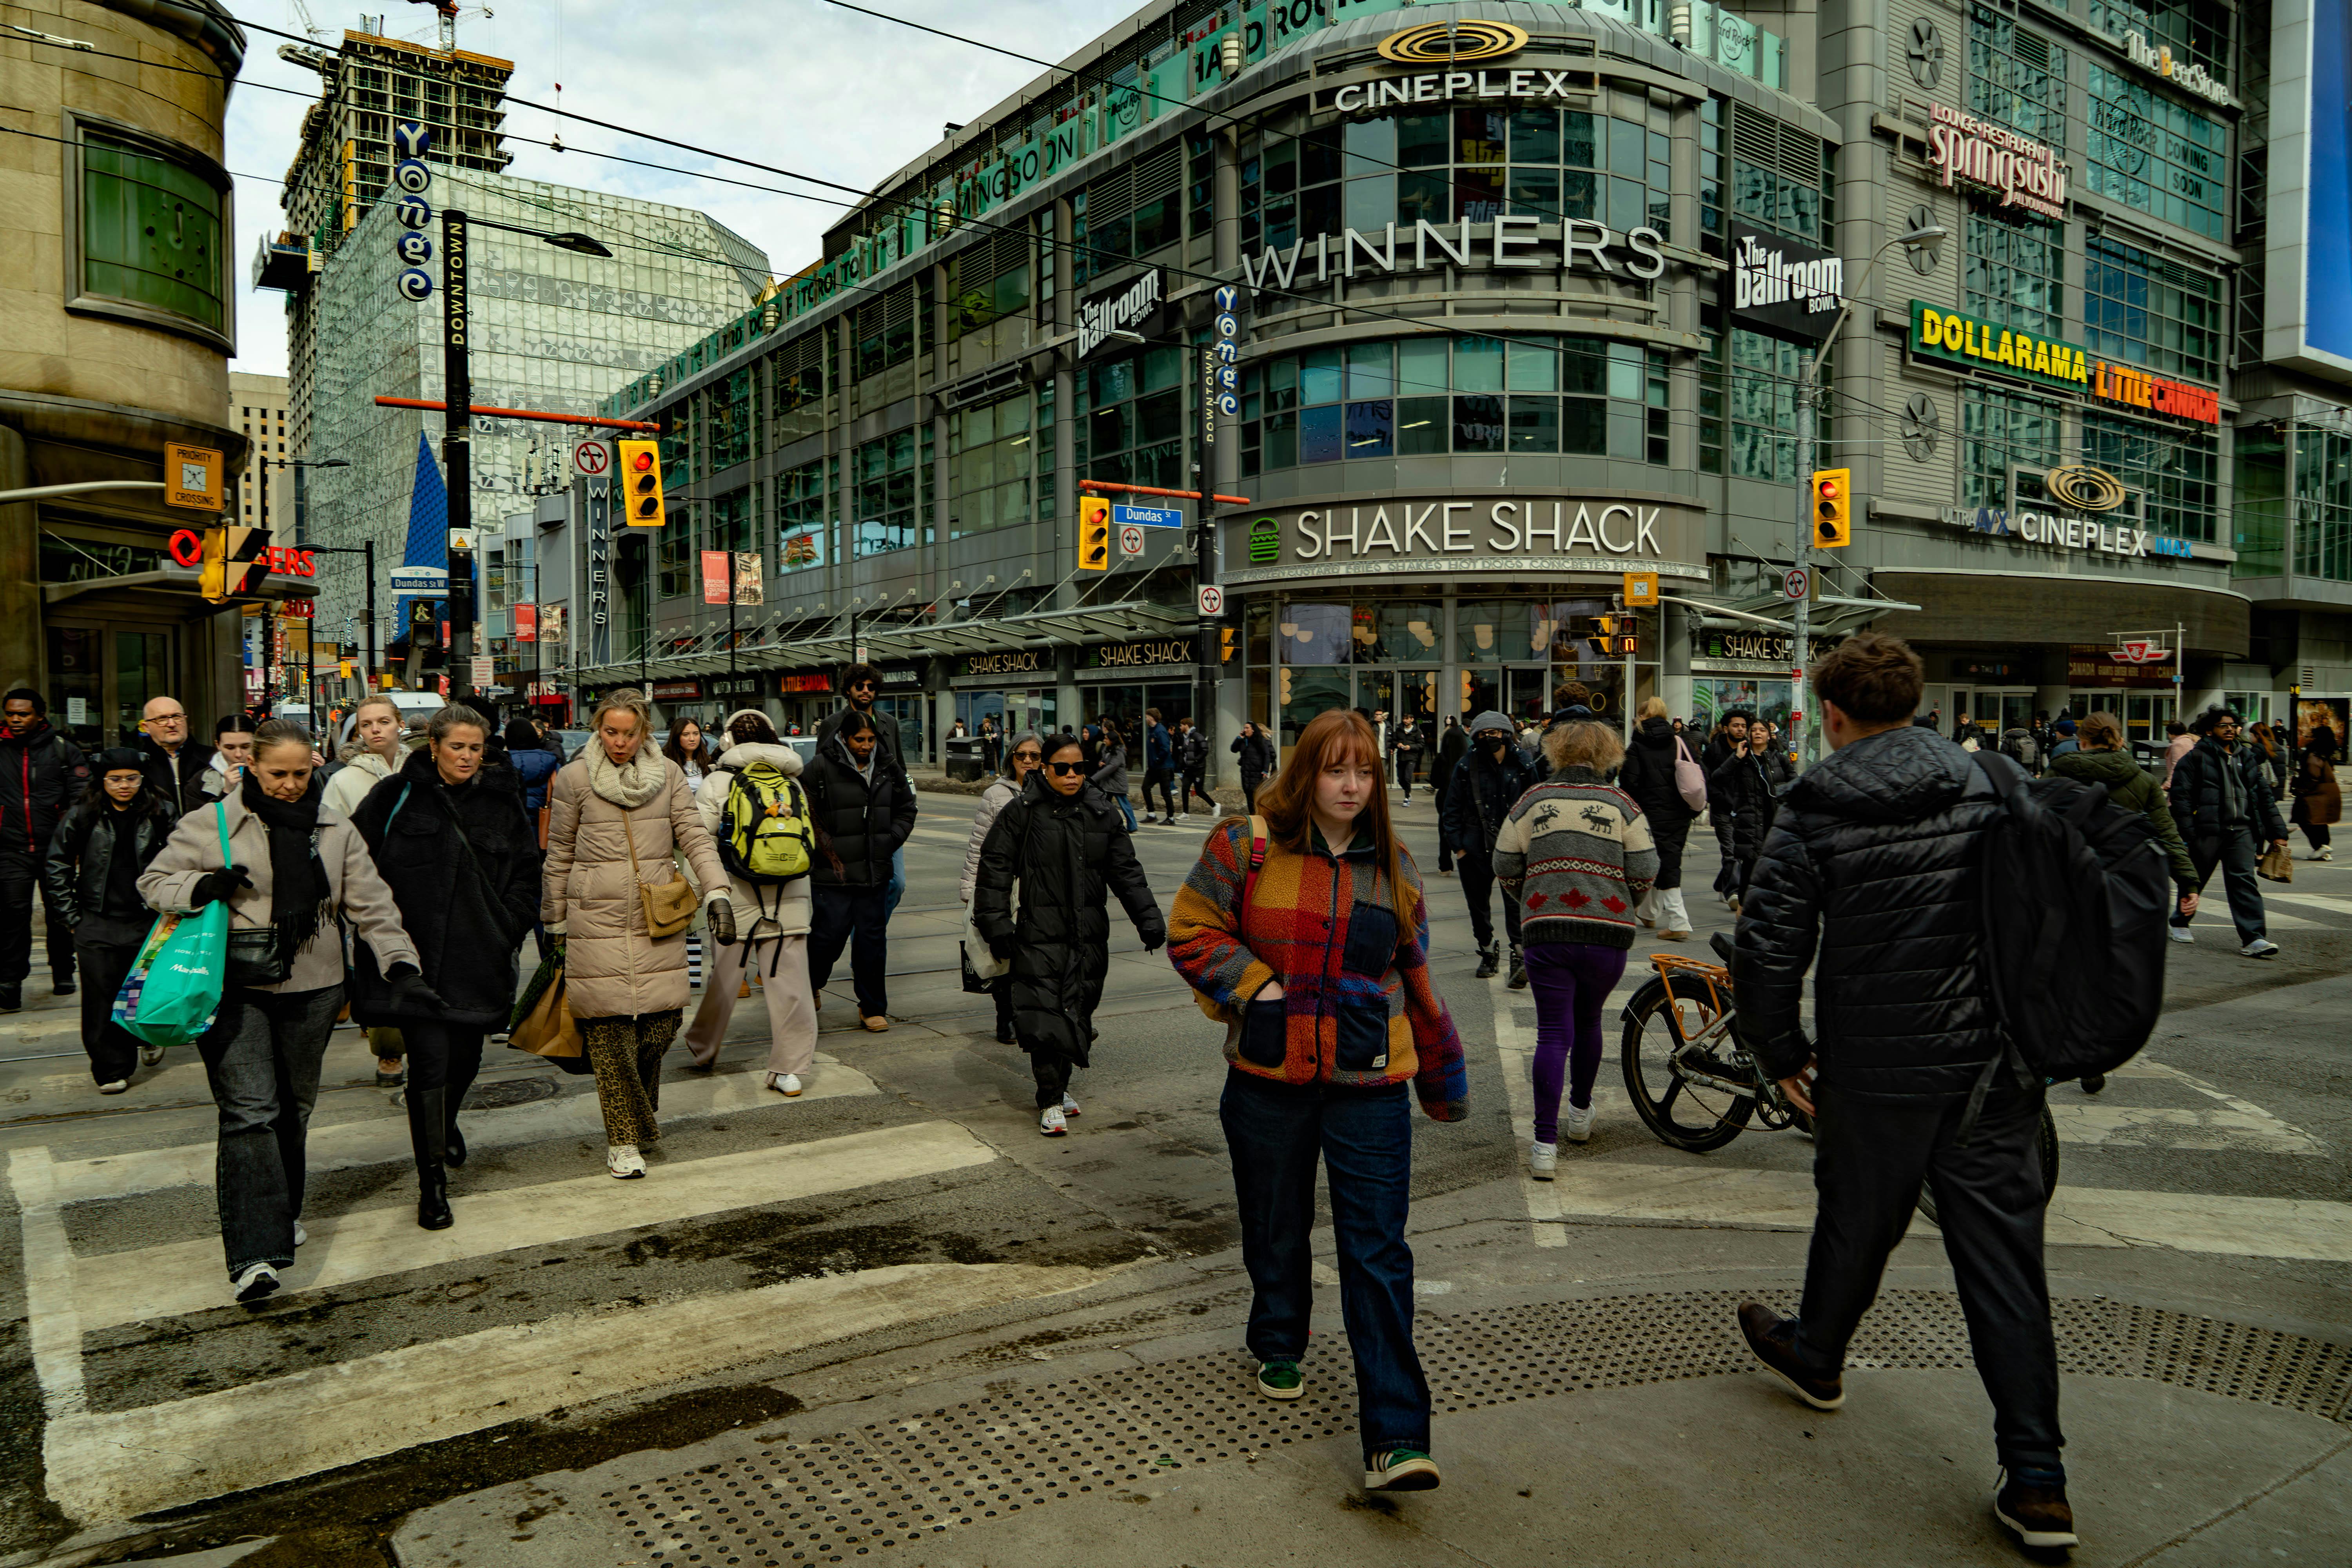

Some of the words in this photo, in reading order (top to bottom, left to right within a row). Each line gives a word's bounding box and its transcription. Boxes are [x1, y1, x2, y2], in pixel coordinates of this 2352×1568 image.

[1195, 21, 1264, 83] HAD
[1719, 26, 1731, 39] ard
[1732, 29, 1750, 51] Rock
[2124, 29, 2159, 71] The
[2157, 45, 2194, 91] Beer
[2191, 64, 2229, 106] Store
[1335, 71, 1569, 112] CINEPLEX
[1931, 102, 1978, 134] LOUNGE
[1980, 123, 2047, 162] RESTAURANT
[2167, 139, 2208, 172] COMING
[2173, 172, 2203, 200] SOON
[396, 123, 432, 301] Yonge
[1241, 215, 1665, 297] WINNERS
[1738, 236, 1767, 267] The
[450, 221, 465, 345] DOWNTOWN
[1735, 247, 1843, 309] ballroom
[1078, 269, 1160, 359] ballroom
[1082, 301, 1099, 324] The
[1131, 303, 1154, 327] BOWL
[1808, 295, 1836, 314] BOWL
[1216, 286, 1239, 417] Yonge
[1921, 308, 2088, 384] DOLLARAMA
[176, 448, 213, 463] PRIORITY
[175, 492, 215, 507] CROSSING
[1126, 508, 1162, 523] Dundas
[1296, 502, 1475, 558] SHAKE
[1488, 501, 1661, 555] SHACK
[1940, 507, 1976, 527] ULTRA
[1974, 508, 2009, 536] AVX
[2019, 512, 2148, 557] CINEPLEX
[2155, 537, 2193, 558] IMAX
[589, 487, 608, 624] WINNERS
[1246, 569, 1287, 581] FROZEN
[1288, 562, 1339, 577] CUSTARD
[1346, 560, 1381, 573] FRIES
[1388, 558, 1442, 571] SHAKES
[1448, 558, 1481, 570] HOT
[1481, 557, 1523, 570] DOGS
[1530, 557, 1609, 570] CONCRETES
[1613, 560, 1654, 573] FLOATS
[1658, 564, 1680, 575] BEER
[395, 579, 427, 588] Dundas
[436, 579, 445, 588] W
[284, 599, 315, 618] 302
[1100, 643, 1142, 667] SHAKE
[1144, 641, 1191, 664] SHACK
[1625, 638, 1634, 651] 17
[1724, 635, 1771, 659] SHAKE
[1773, 638, 1818, 661] SHK
[882, 671, 917, 683] ANNABIS
[969, 653, 1002, 675] SHAKE
[1003, 652, 1038, 671] SHACK
